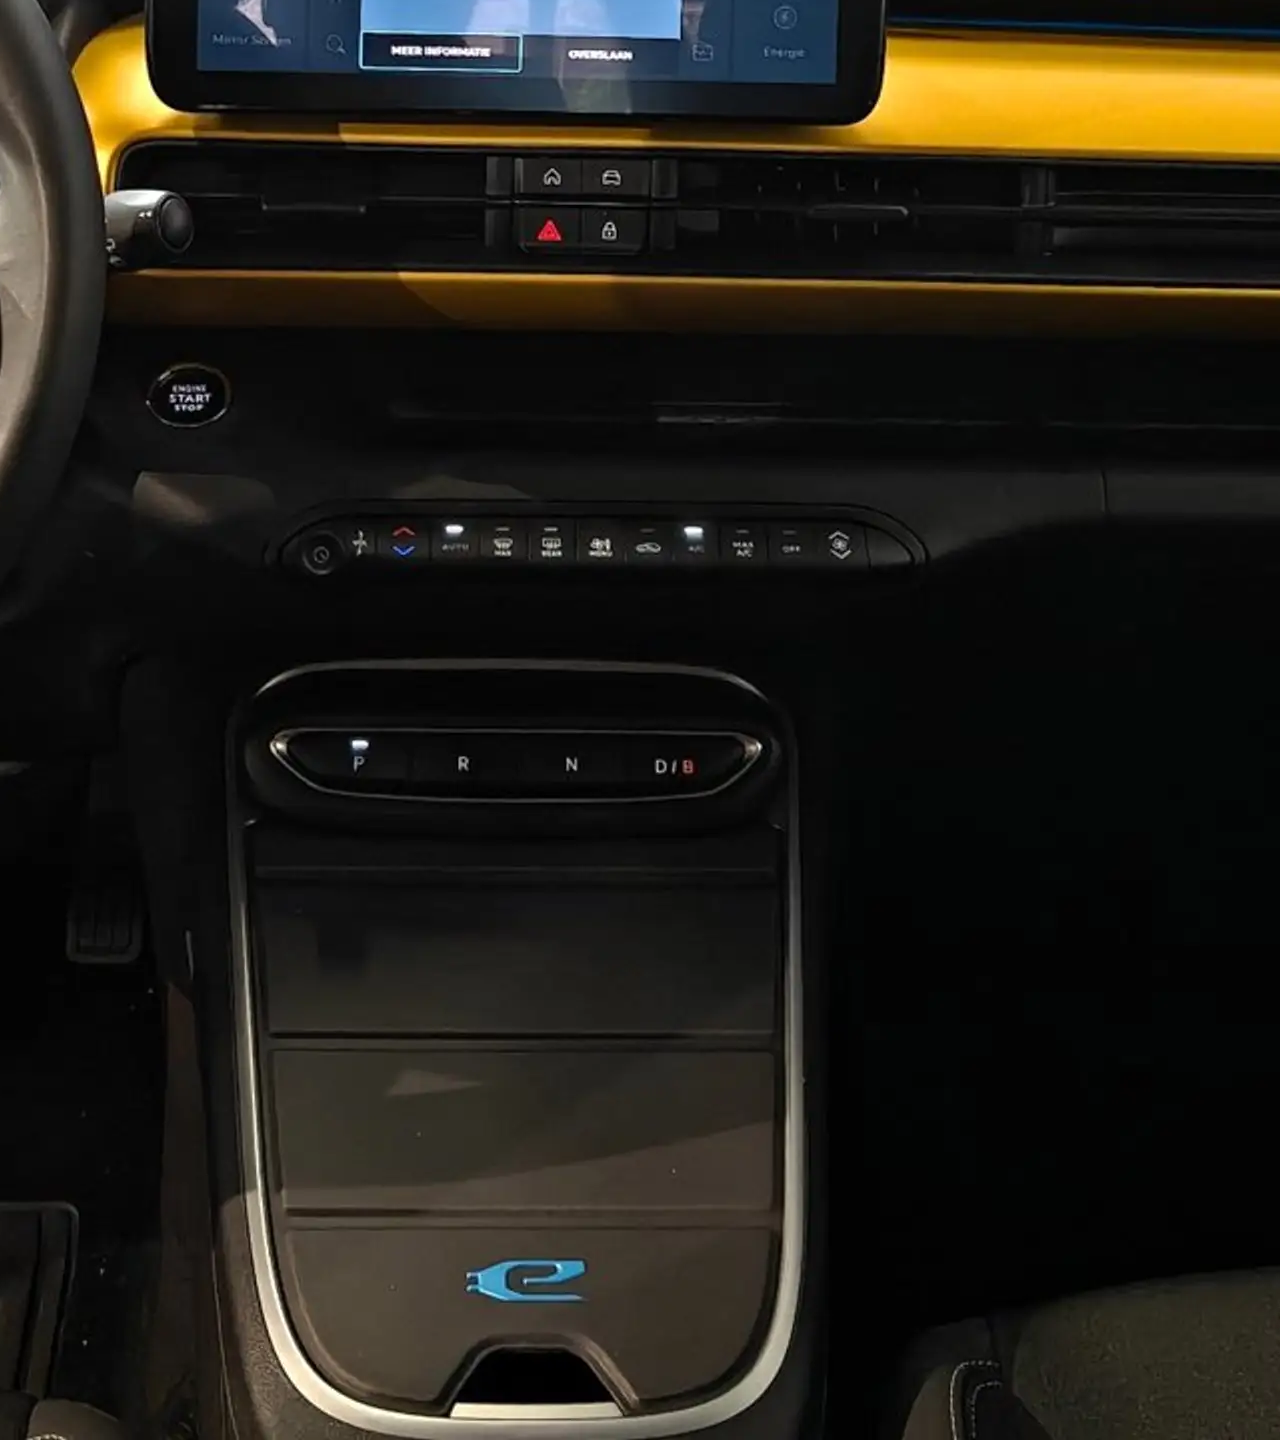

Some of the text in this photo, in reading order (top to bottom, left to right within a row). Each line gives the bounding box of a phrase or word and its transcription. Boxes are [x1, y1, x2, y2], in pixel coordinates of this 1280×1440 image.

[391, 45, 491, 58] MEER INFORMATIE
[568, 49, 633, 61] OVERSLAAN
[169, 393, 212, 404] START
[174, 404, 205, 413] STOP
[353, 757, 366, 772] P
[458, 757, 471, 772] R
[566, 758, 578, 773] N
